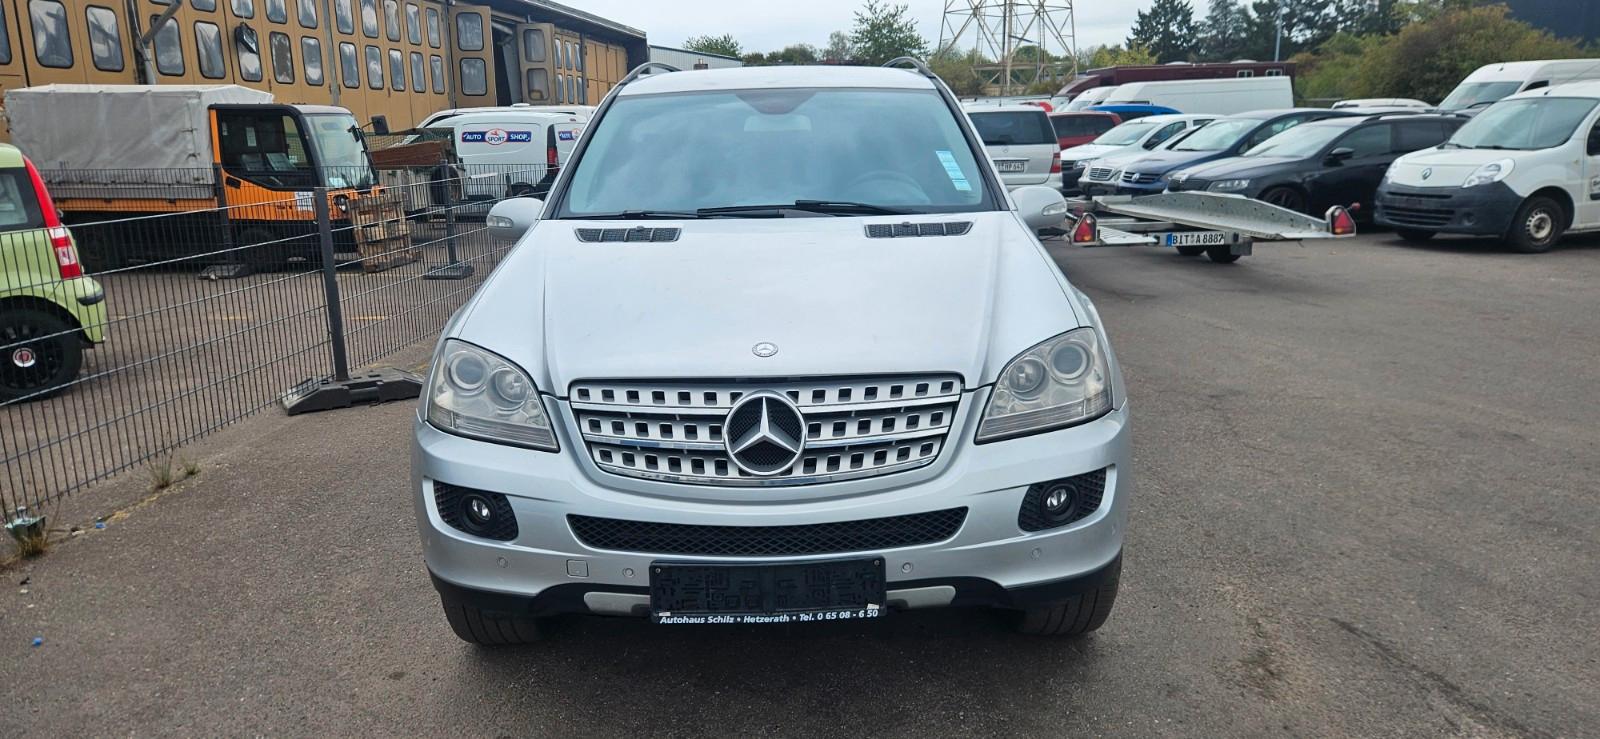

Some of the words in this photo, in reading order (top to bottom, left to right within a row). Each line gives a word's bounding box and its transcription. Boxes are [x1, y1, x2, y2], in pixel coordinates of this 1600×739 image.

[1172, 234, 1190, 244] BIT
[1195, 234, 1201, 244] A
[659, 615, 705, 624] Autohaus
[743, 614, 789, 623] Hetzerath
[799, 613, 815, 622] Tel.
[825, 612, 837, 620] 65
[839, 611, 850, 619] 08
[858, 610, 865, 618] 6
[866, 609, 879, 617] 50
